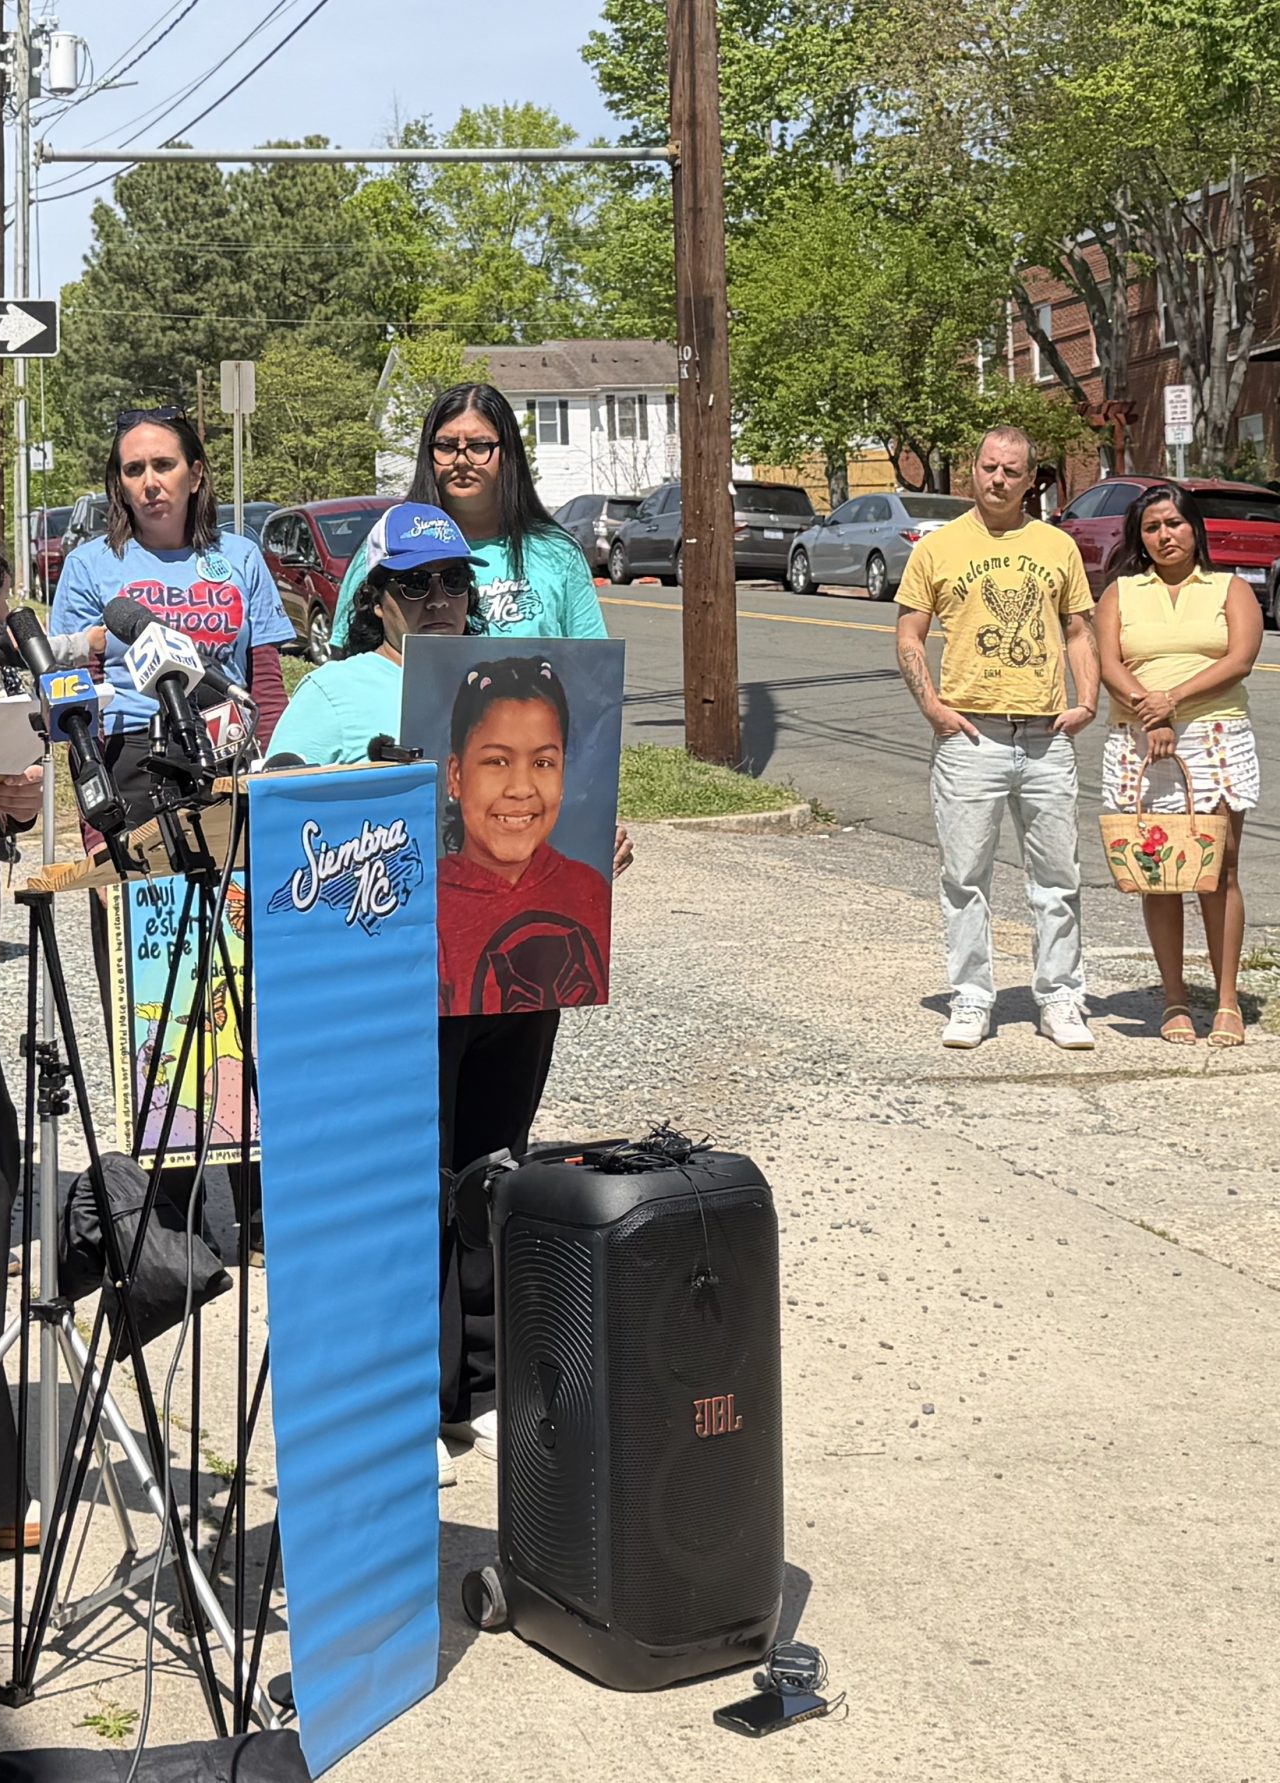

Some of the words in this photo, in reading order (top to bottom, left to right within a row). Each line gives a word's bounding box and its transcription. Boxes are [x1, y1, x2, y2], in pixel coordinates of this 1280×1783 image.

[126, 586, 234, 608] PUBLIC
[951, 555, 1011, 602] Welcome
[1016, 554, 1058, 599] Tattoo
[154, 611, 239, 634] HOOL
[486, 593, 525, 622] NC
[291, 818, 410, 911] Siembra
[345, 858, 400, 925] NC
[137, 935, 161, 961] de
[166, 941, 193, 970] pe
[693, 1393, 743, 1438] JBL
